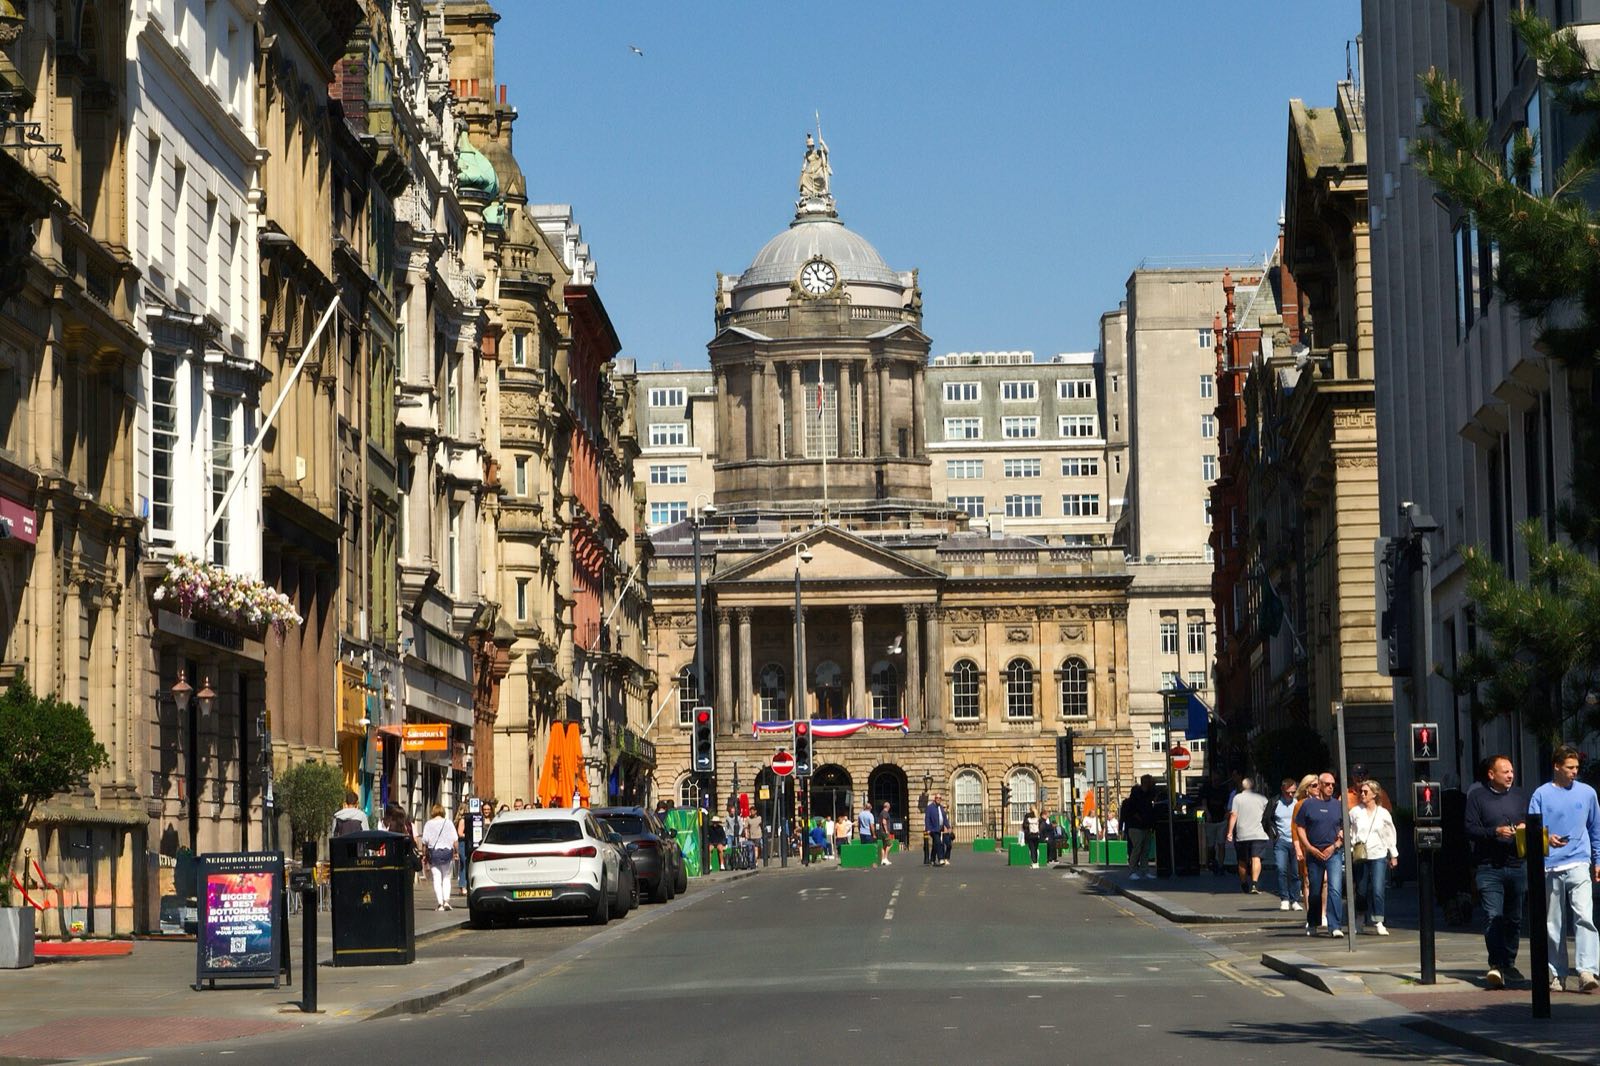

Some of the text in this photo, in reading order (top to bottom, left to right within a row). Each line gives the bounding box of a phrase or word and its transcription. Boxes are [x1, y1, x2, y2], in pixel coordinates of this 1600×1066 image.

[205, 855, 278, 864] NEIGHBOURHOOD
[220, 893, 257, 901] BIGGEST
[232, 900, 255, 908] BEST
[209, 907, 269, 916] BOTTOMLESS
[219, 914, 271, 923] LIVERPOOL
